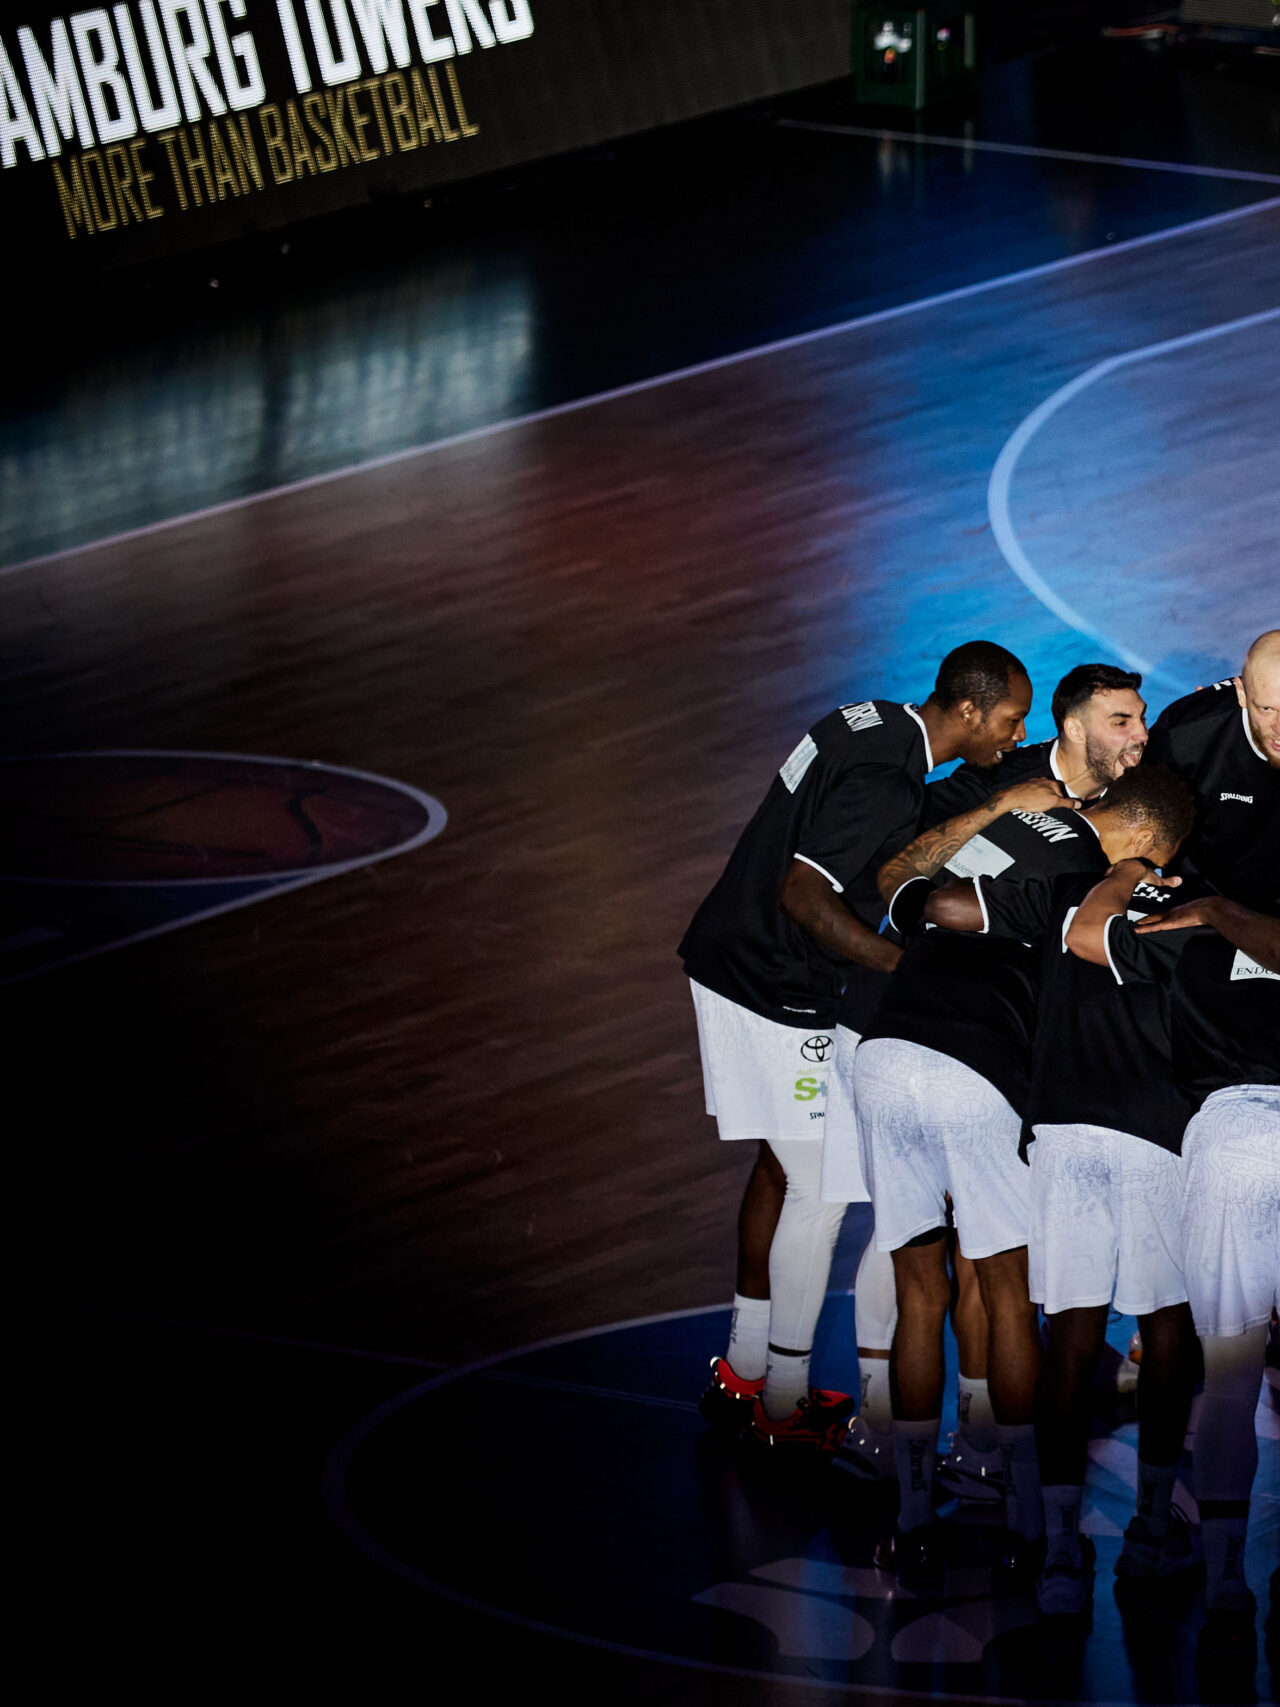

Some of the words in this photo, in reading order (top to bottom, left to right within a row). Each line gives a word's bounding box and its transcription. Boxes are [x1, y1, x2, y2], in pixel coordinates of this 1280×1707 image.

[51, 138, 164, 239] MORE
[157, 112, 265, 210] THAN
[259, 60, 481, 184] BASKETBALL
[1219, 792, 1254, 804] SPALDING
